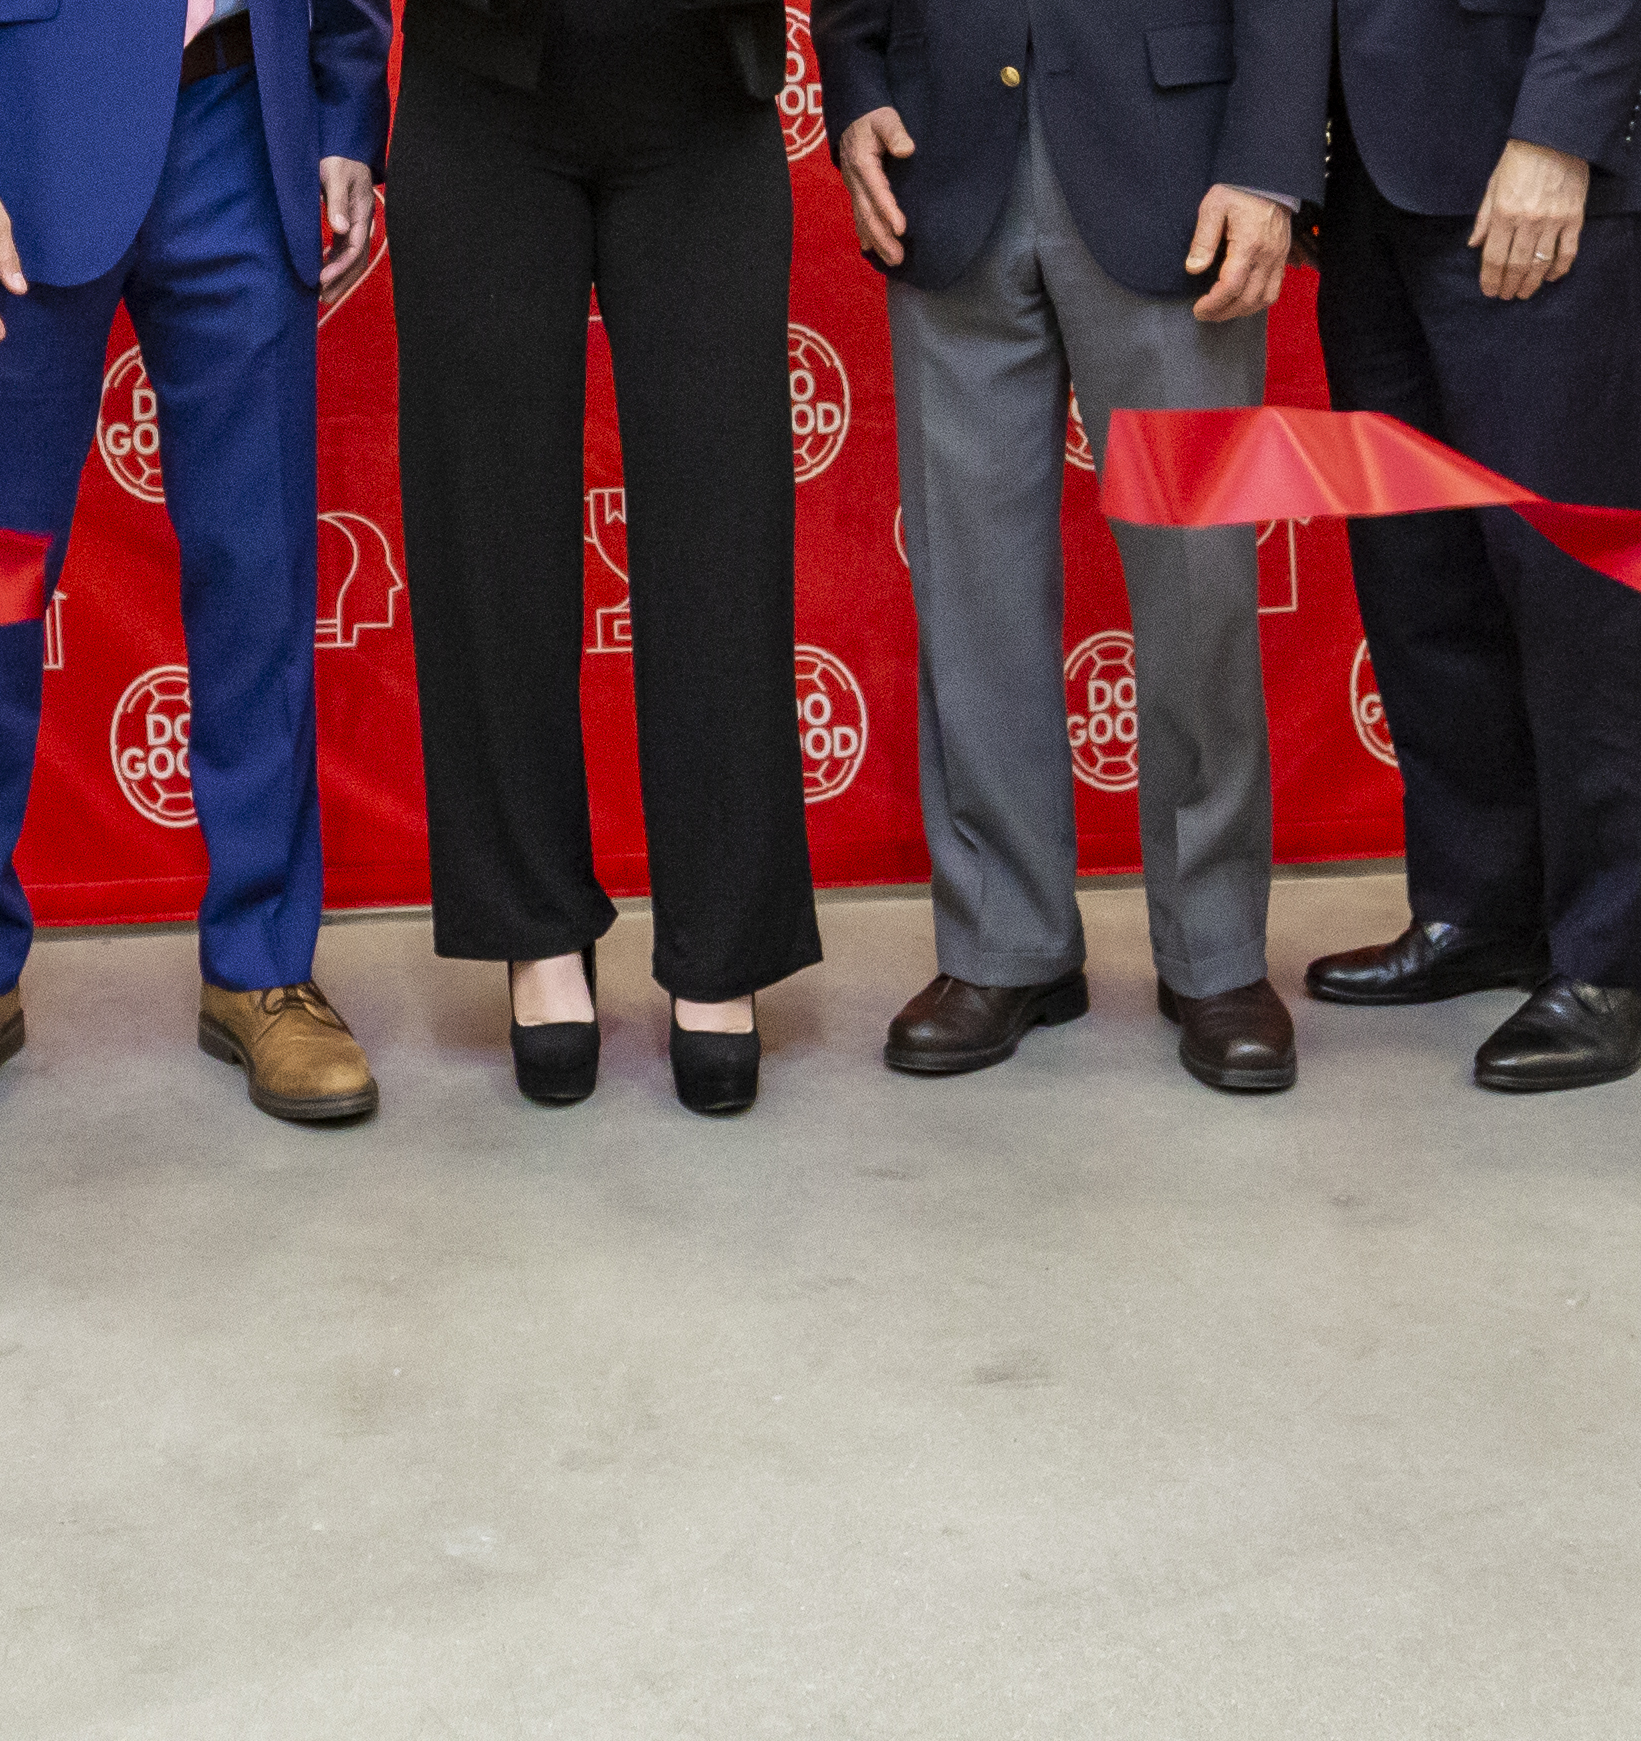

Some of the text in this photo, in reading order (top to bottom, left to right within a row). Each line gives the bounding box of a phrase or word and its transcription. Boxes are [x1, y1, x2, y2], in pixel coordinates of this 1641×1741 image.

[788, 369, 816, 402] O
[796, 692, 832, 726] O
[1087, 677, 1137, 713] DO
[1066, 711, 1138, 747] GOO
